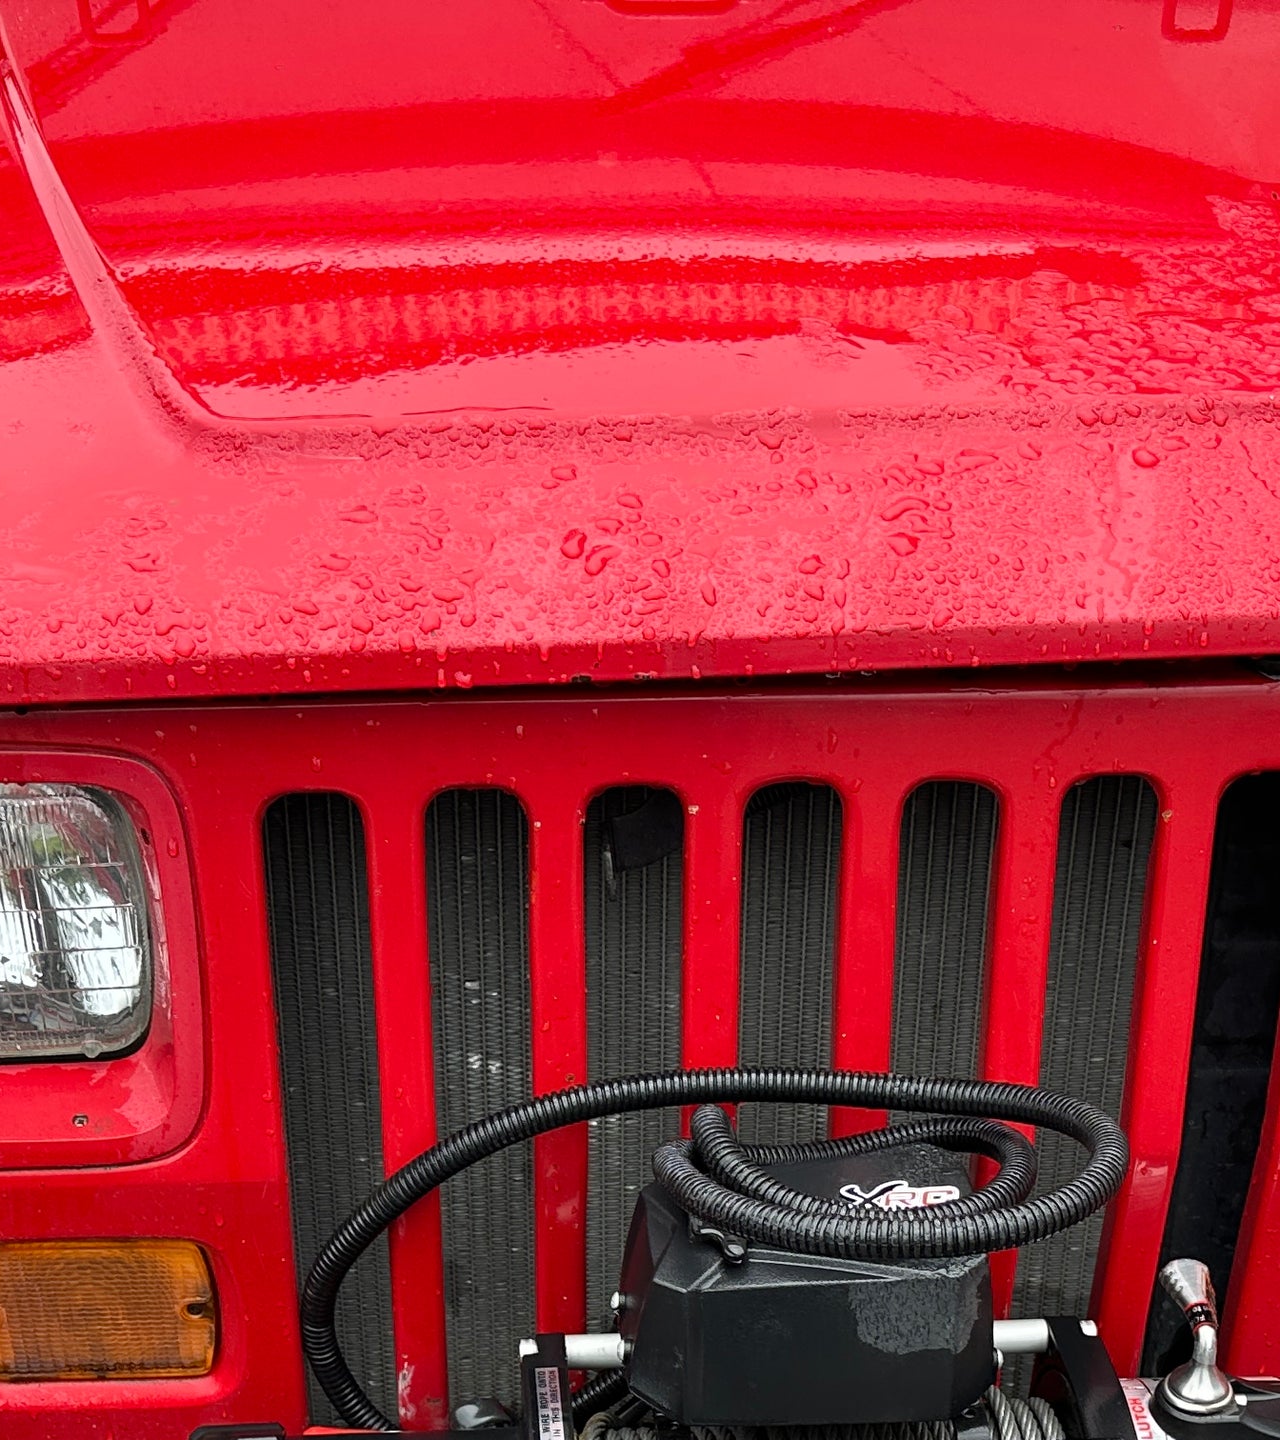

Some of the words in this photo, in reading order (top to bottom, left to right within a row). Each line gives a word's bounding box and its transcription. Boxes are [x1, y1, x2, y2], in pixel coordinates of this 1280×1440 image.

[537, 1371, 547, 1388] ONTO
[548, 1370, 559, 1404] DIRECTION
[540, 1391, 549, 1409] ROPE
[541, 1413, 550, 1433] WIRE
[552, 1407, 560, 1423] THIS
[553, 1428, 561, 1437] IN
